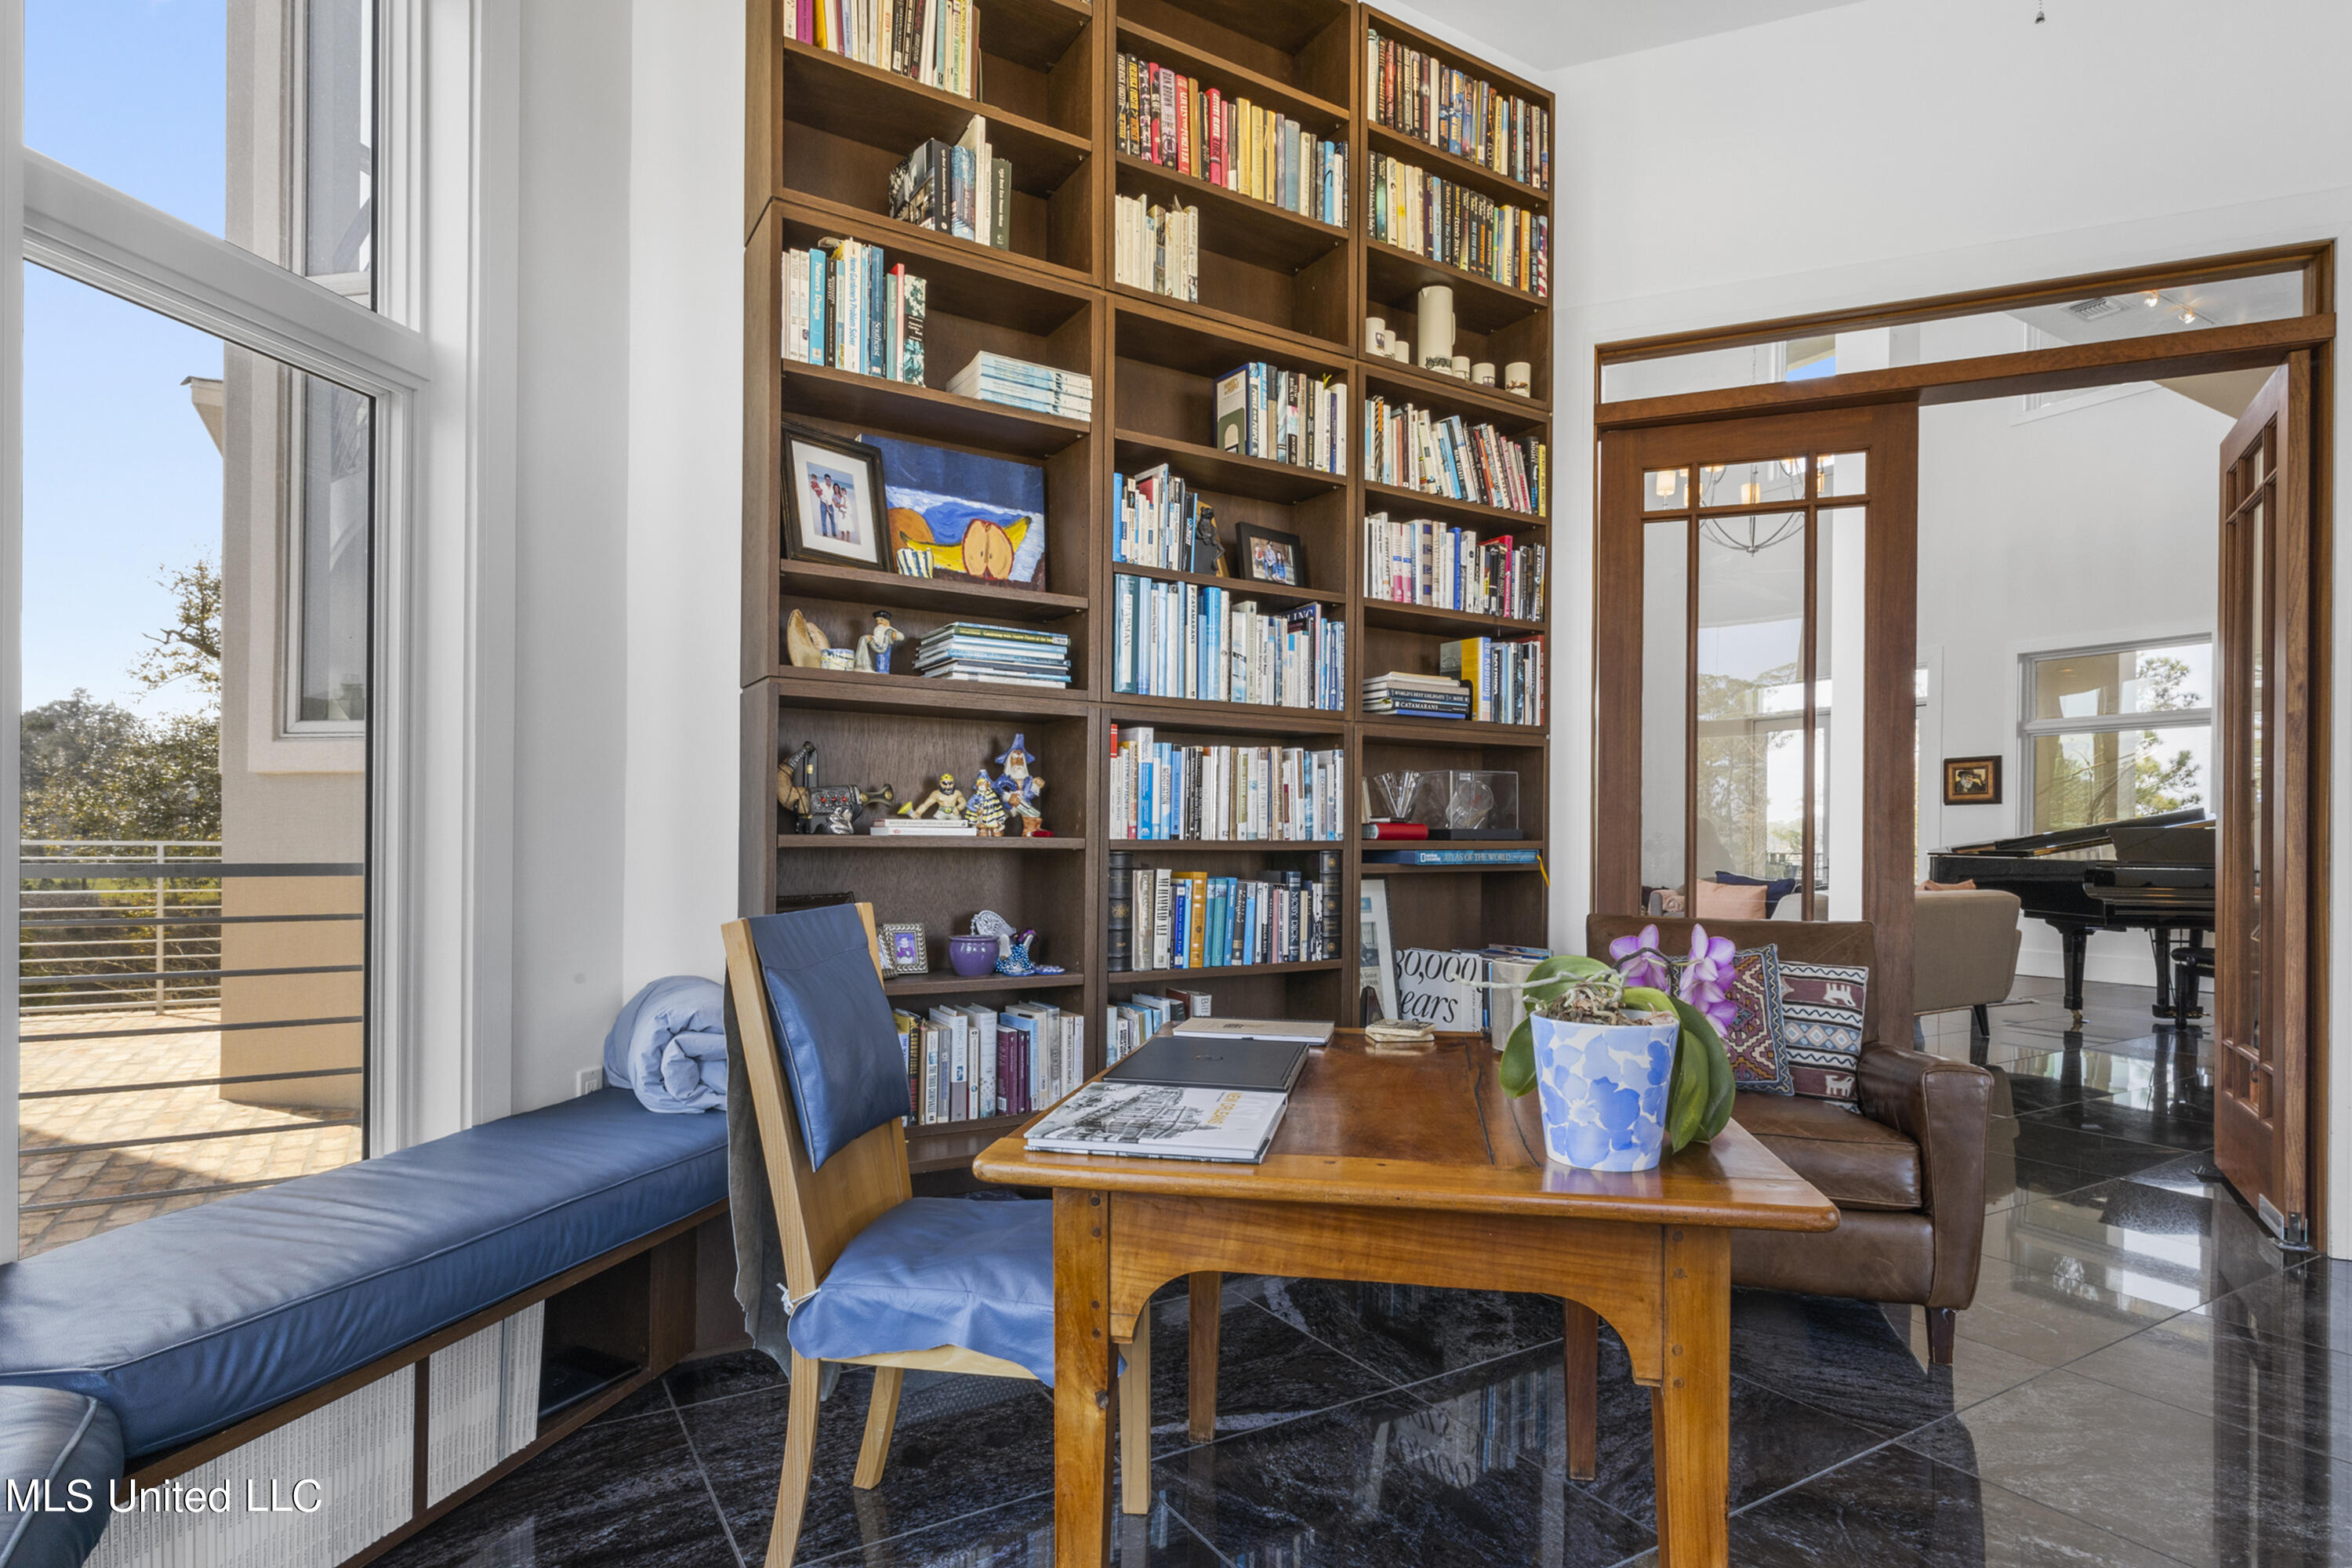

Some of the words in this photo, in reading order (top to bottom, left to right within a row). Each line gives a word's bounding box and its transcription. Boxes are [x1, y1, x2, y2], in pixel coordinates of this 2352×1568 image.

[1163, 72, 1173, 85] DAN
[1163, 85, 1173, 107] BROWN
[813, 293, 822, 320] Design
[1400, 702, 1438, 710] CATAMARANS
[1473, 852, 1486, 861] THE
[1486, 852, 1512, 861] WORLD
[1157, 878, 1168, 920] MUHAMMAD
[1157, 924, 1168, 935] ALI
[1399, 991, 1458, 1023] ears
